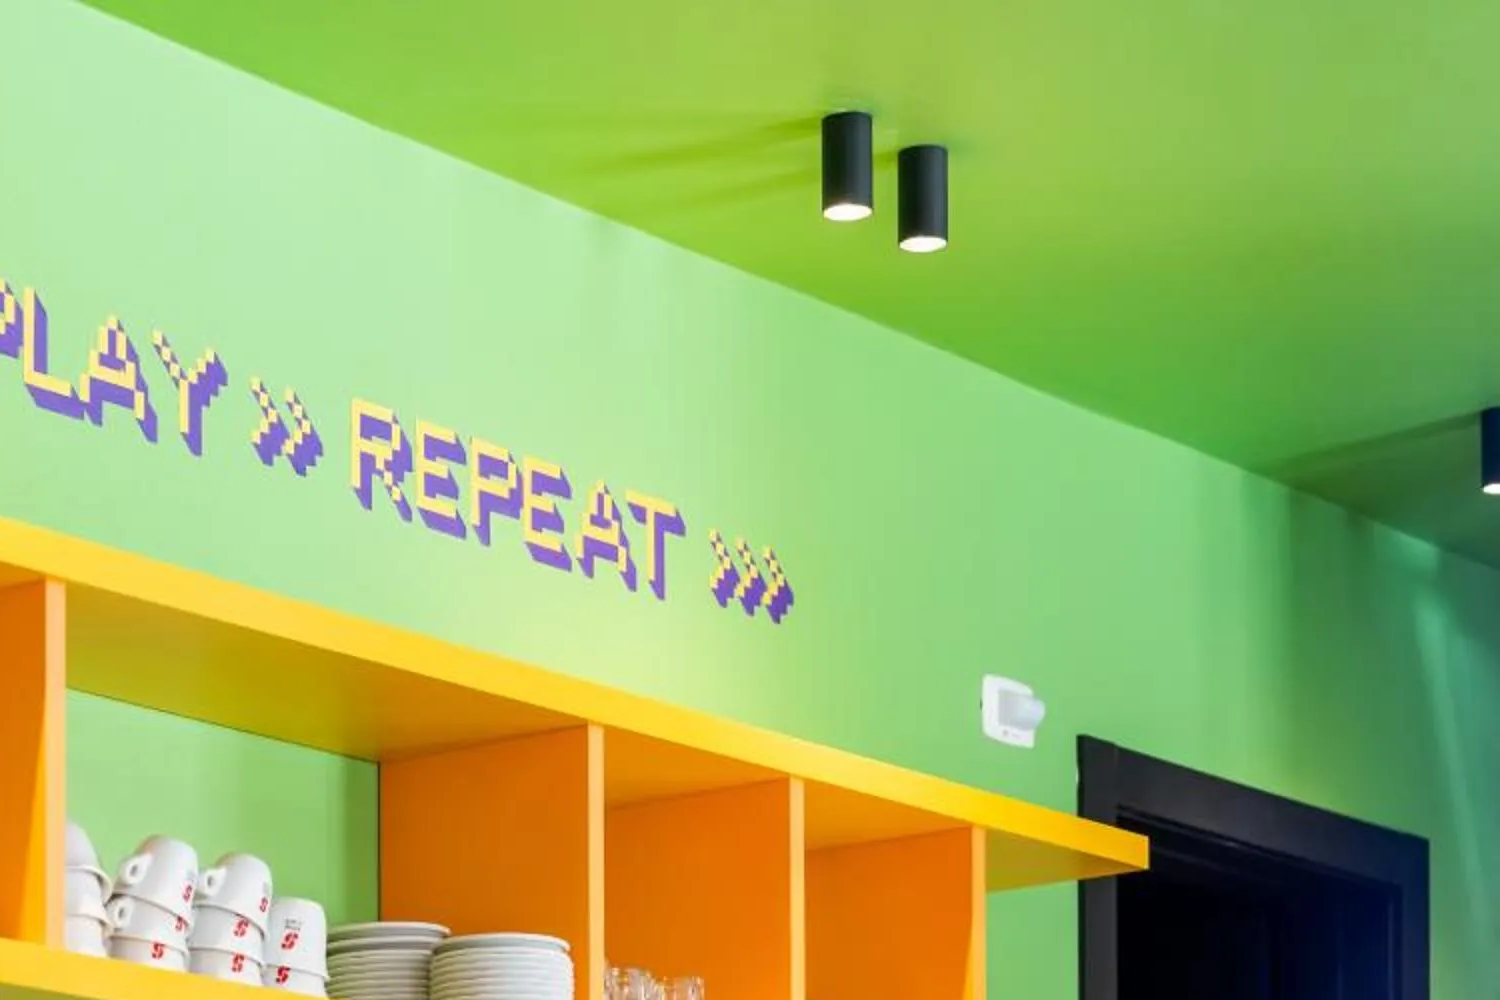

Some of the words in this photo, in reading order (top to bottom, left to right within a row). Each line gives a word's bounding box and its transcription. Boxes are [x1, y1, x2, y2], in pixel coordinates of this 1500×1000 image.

[350, 398, 685, 600] REPEAT
[234, 918, 249, 937] S
[281, 932, 299, 949] S
[152, 942, 166, 959] S
[231, 953, 245, 973] S
[275, 966, 291, 984] S
